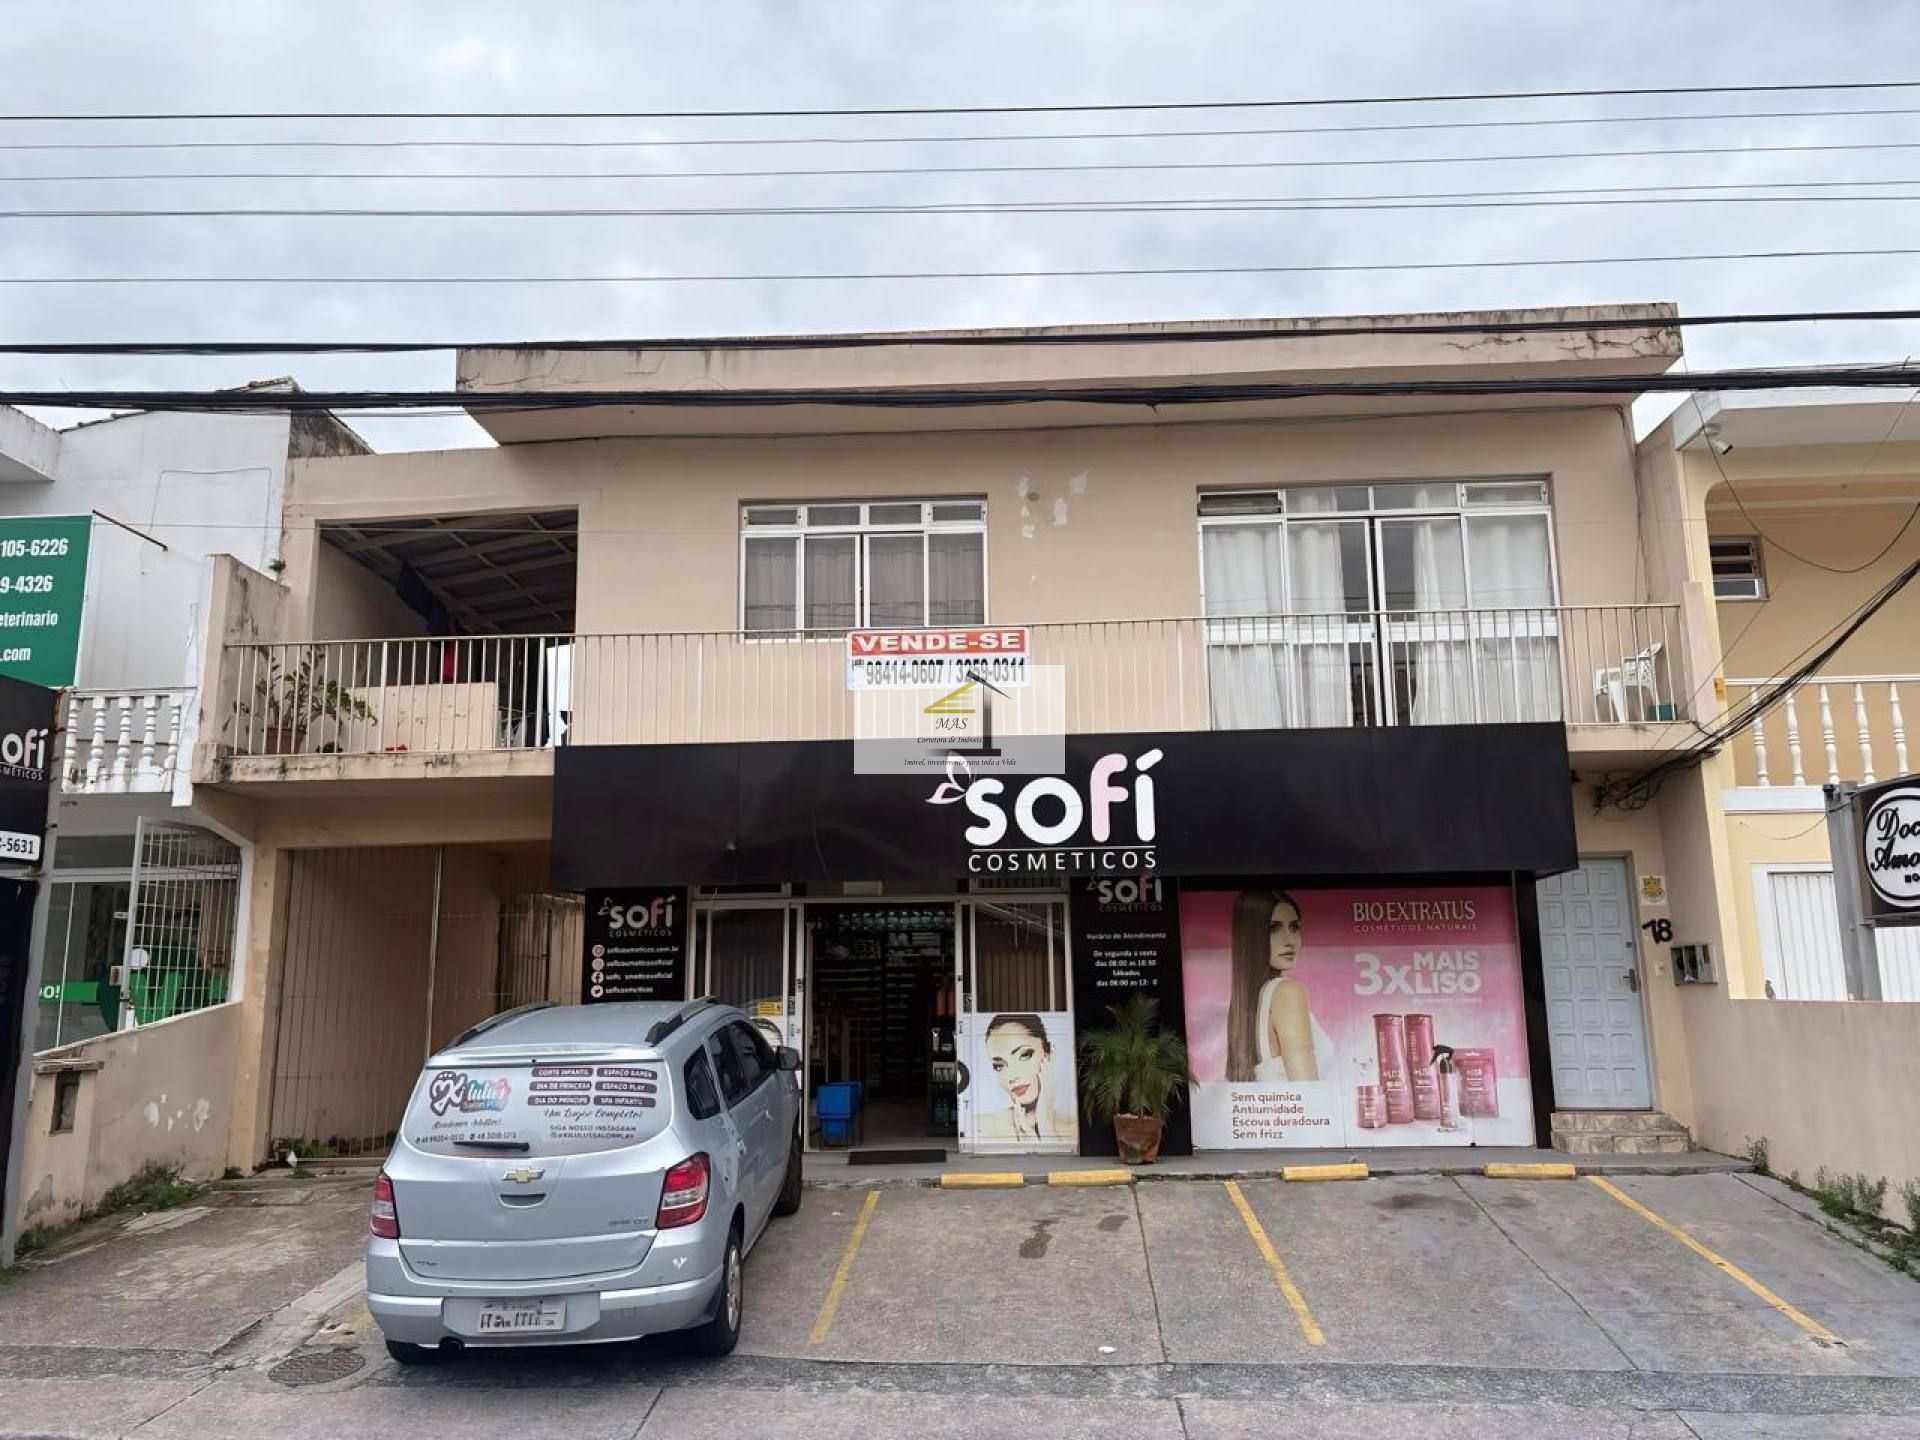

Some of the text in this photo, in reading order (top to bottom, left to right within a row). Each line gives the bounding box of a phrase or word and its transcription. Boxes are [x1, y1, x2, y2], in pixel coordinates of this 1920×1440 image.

[1, 538, 69, 557] 105-6226
[0, 575, 54, 594] 9-4326
[854, 632, 1021, 652] VENDE-SE
[867, 659, 943, 684] 98414-0607
[968, 851, 1156, 871] COSMETICOS
[1426, 922, 1477, 931] NATURAIS
[1642, 918, 1673, 944] 18
[1413, 950, 1479, 971] MAIS
[1415, 971, 1482, 994] LISO
[1231, 1092, 1255, 1101] Sem
[1232, 1104, 1304, 1114] Antiumidade
[1232, 1116, 1330, 1126] Escova duradoura
[1232, 1129, 1284, 1139] Sem frizz
